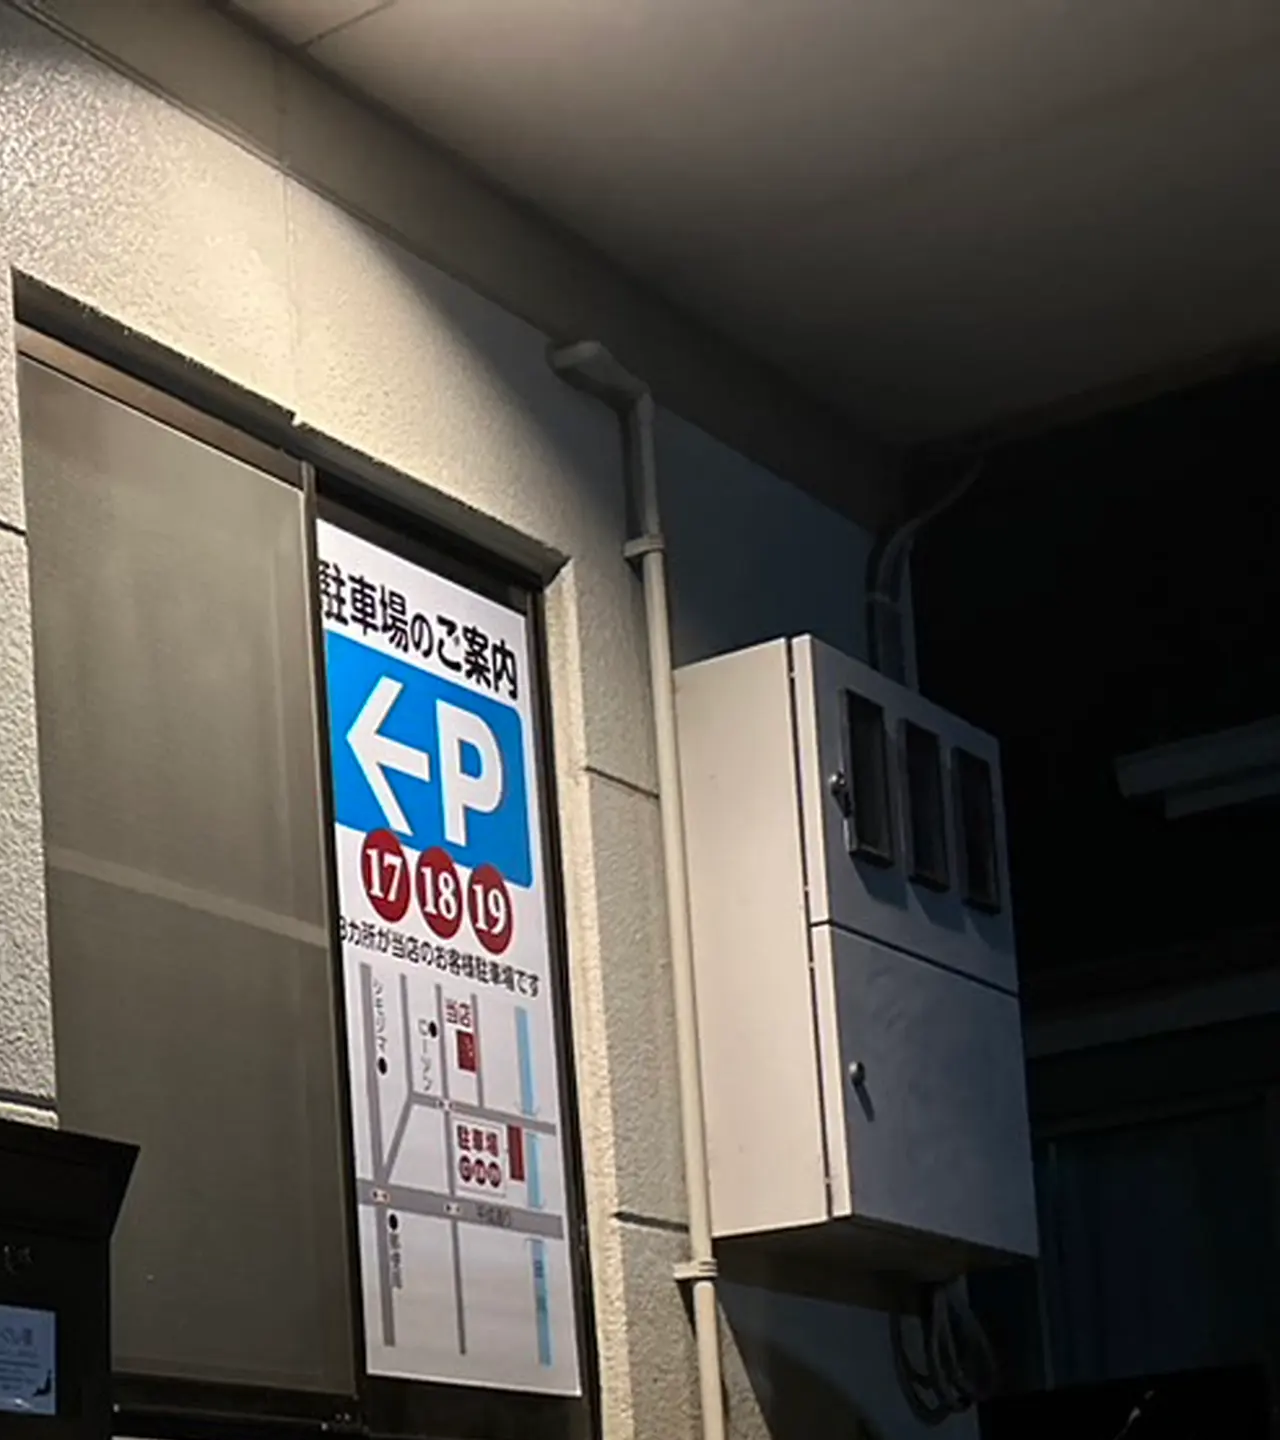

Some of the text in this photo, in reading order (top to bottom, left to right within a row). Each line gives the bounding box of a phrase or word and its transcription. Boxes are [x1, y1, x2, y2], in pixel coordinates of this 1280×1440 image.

[317, 559, 519, 700] 駐車場のご案内
[436, 699, 503, 848] P
[365, 848, 507, 936] 17 18 19
